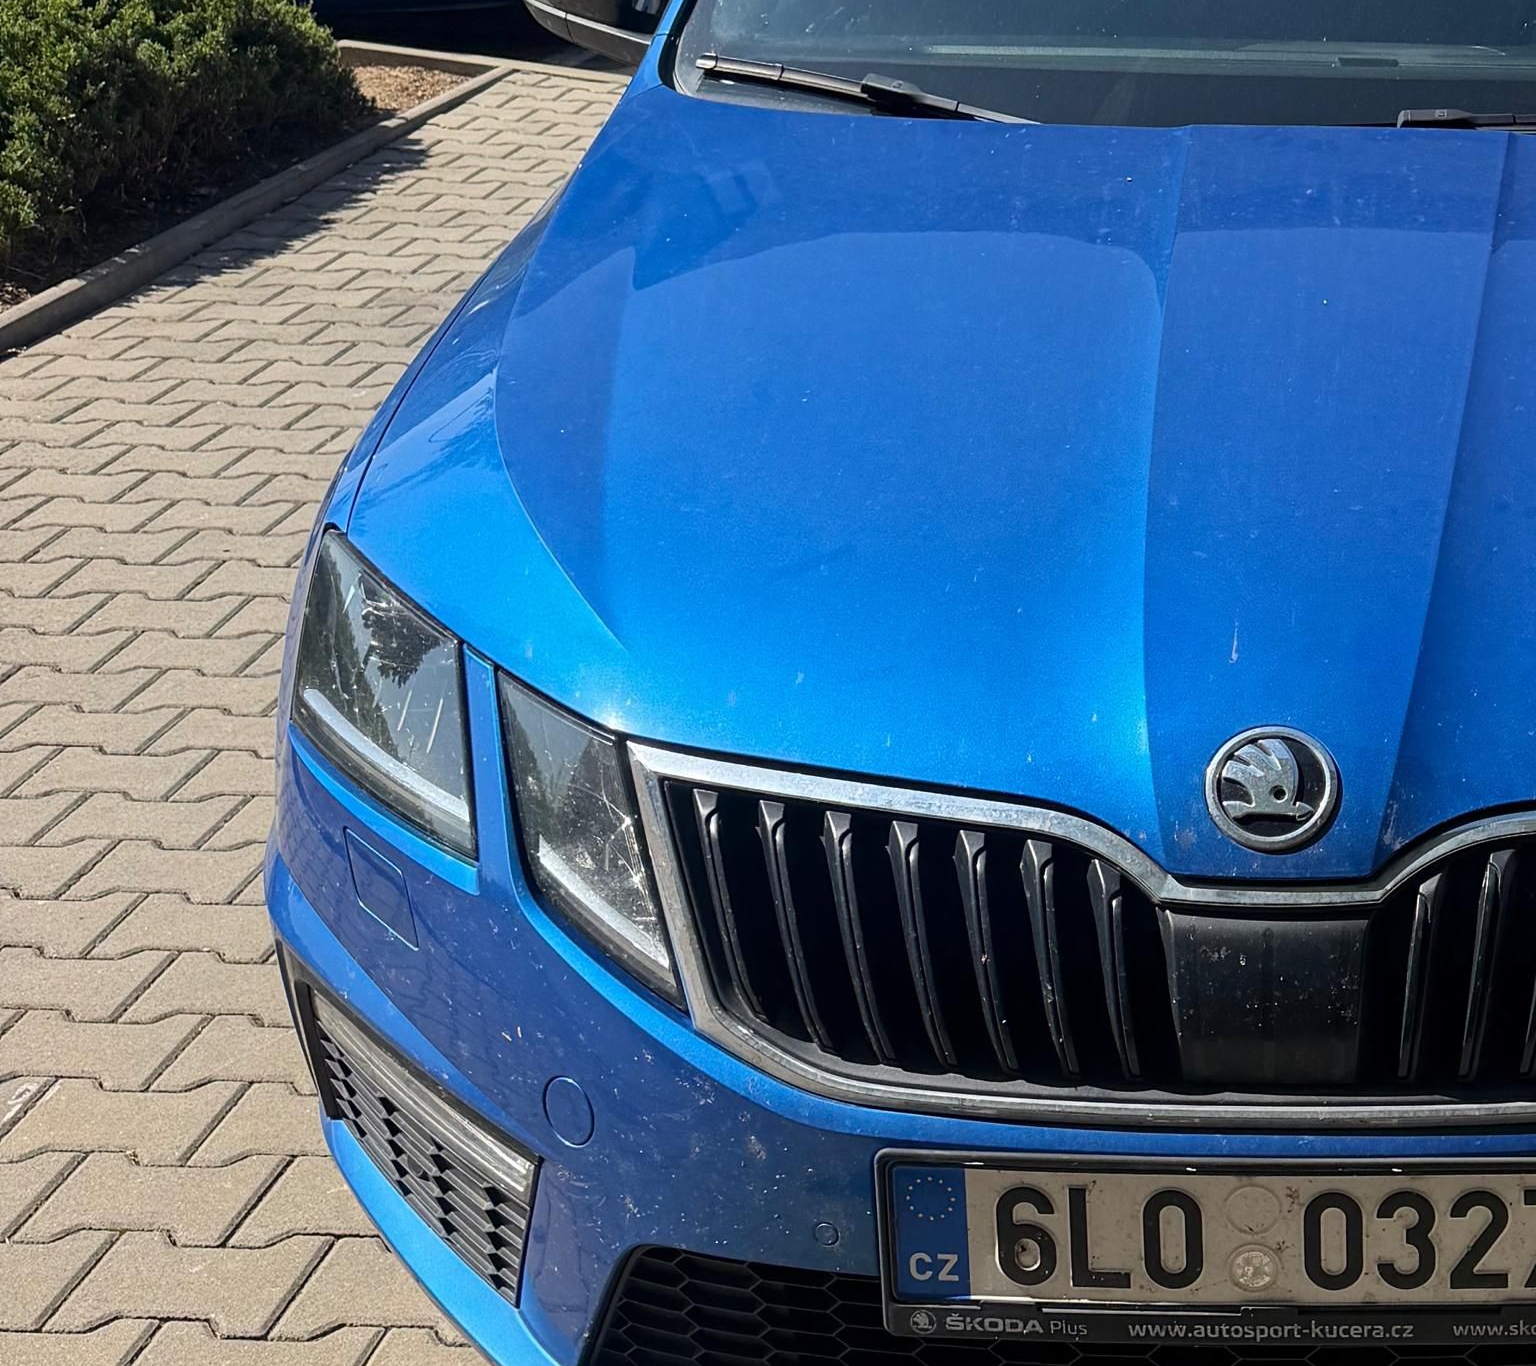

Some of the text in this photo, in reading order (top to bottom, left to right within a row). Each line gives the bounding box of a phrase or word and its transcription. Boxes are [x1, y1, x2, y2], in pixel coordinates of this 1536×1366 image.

[995, 1186, 1204, 1290] 6L0
[908, 1251, 960, 1282] CZ
[945, 1313, 1088, 1336] ŠKODA Plus
[1127, 1319, 1414, 1341] www.autosport-kucera.cz
